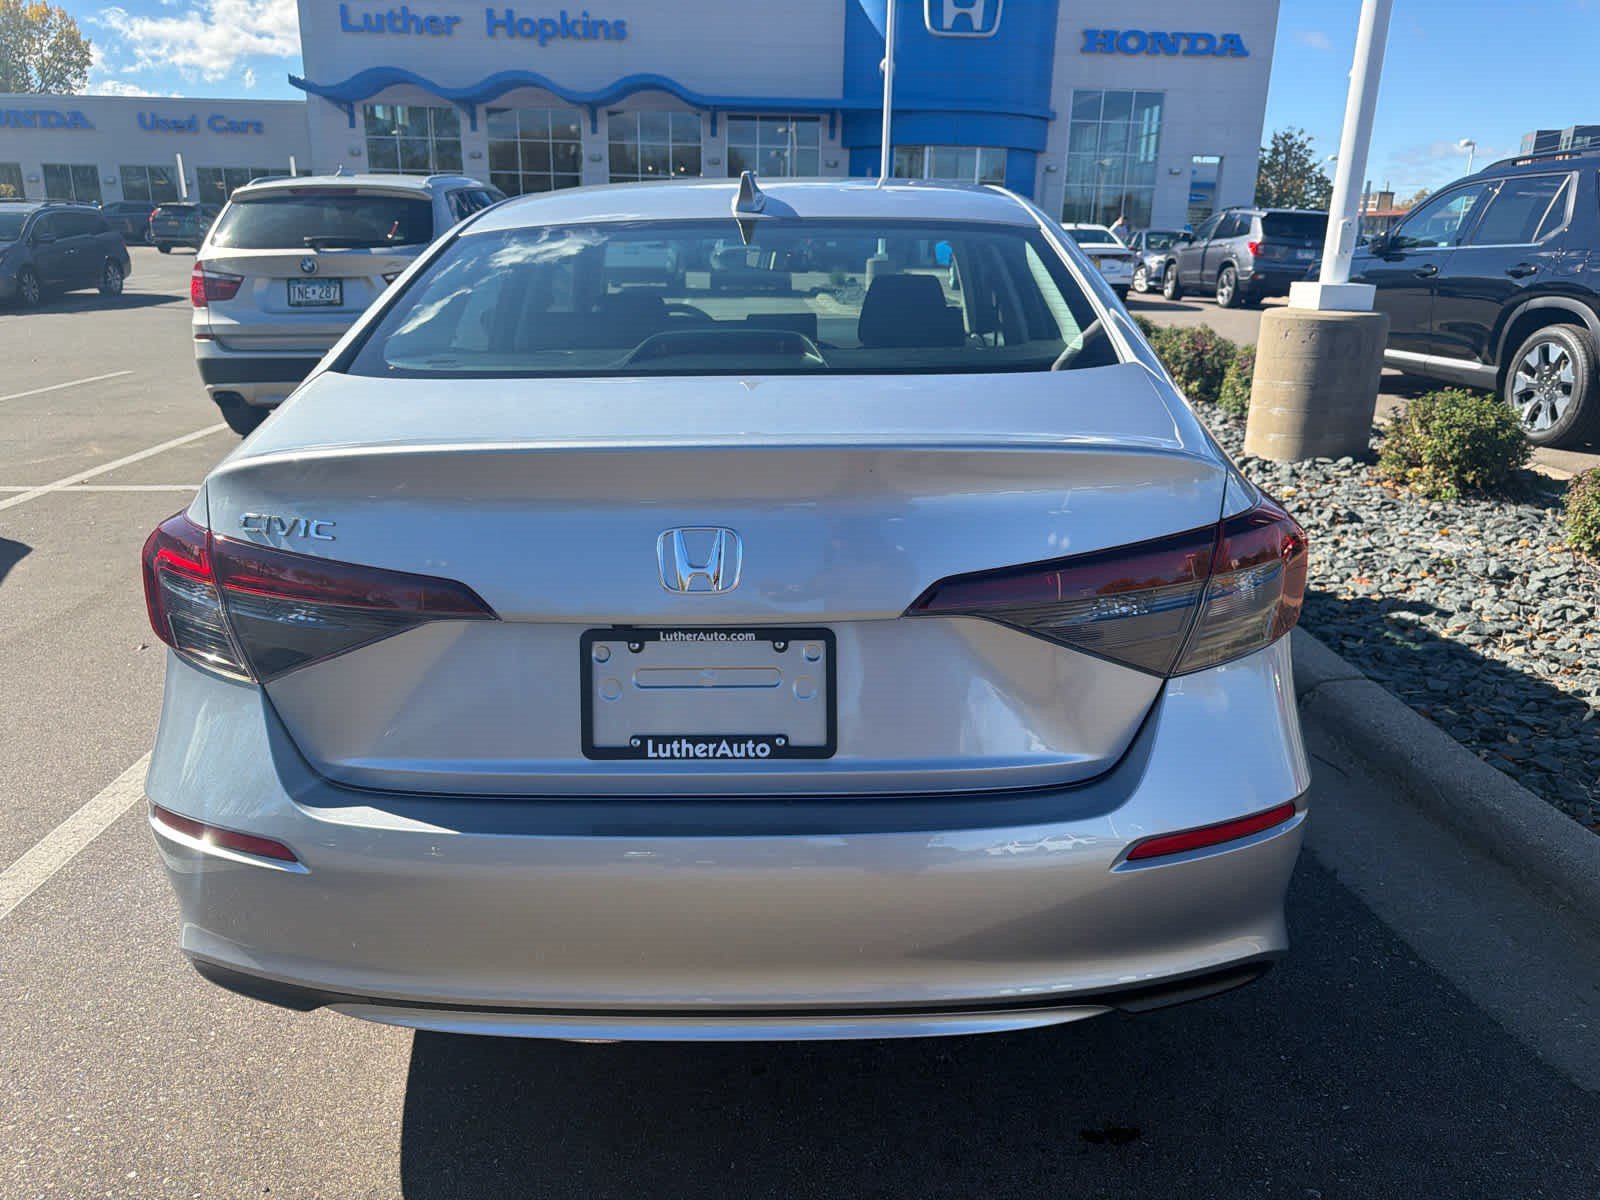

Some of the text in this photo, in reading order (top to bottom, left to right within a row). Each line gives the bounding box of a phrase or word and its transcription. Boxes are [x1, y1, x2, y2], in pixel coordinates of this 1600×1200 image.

[338, 3, 628, 47] Luther Hopkins
[1081, 29, 1249, 57] HONDA
[137, 111, 264, 134] Used Cars
[239, 512, 337, 541] CIVIC
[659, 631, 756, 641] LutherAuto.com
[647, 738, 771, 758] LutherAuto
